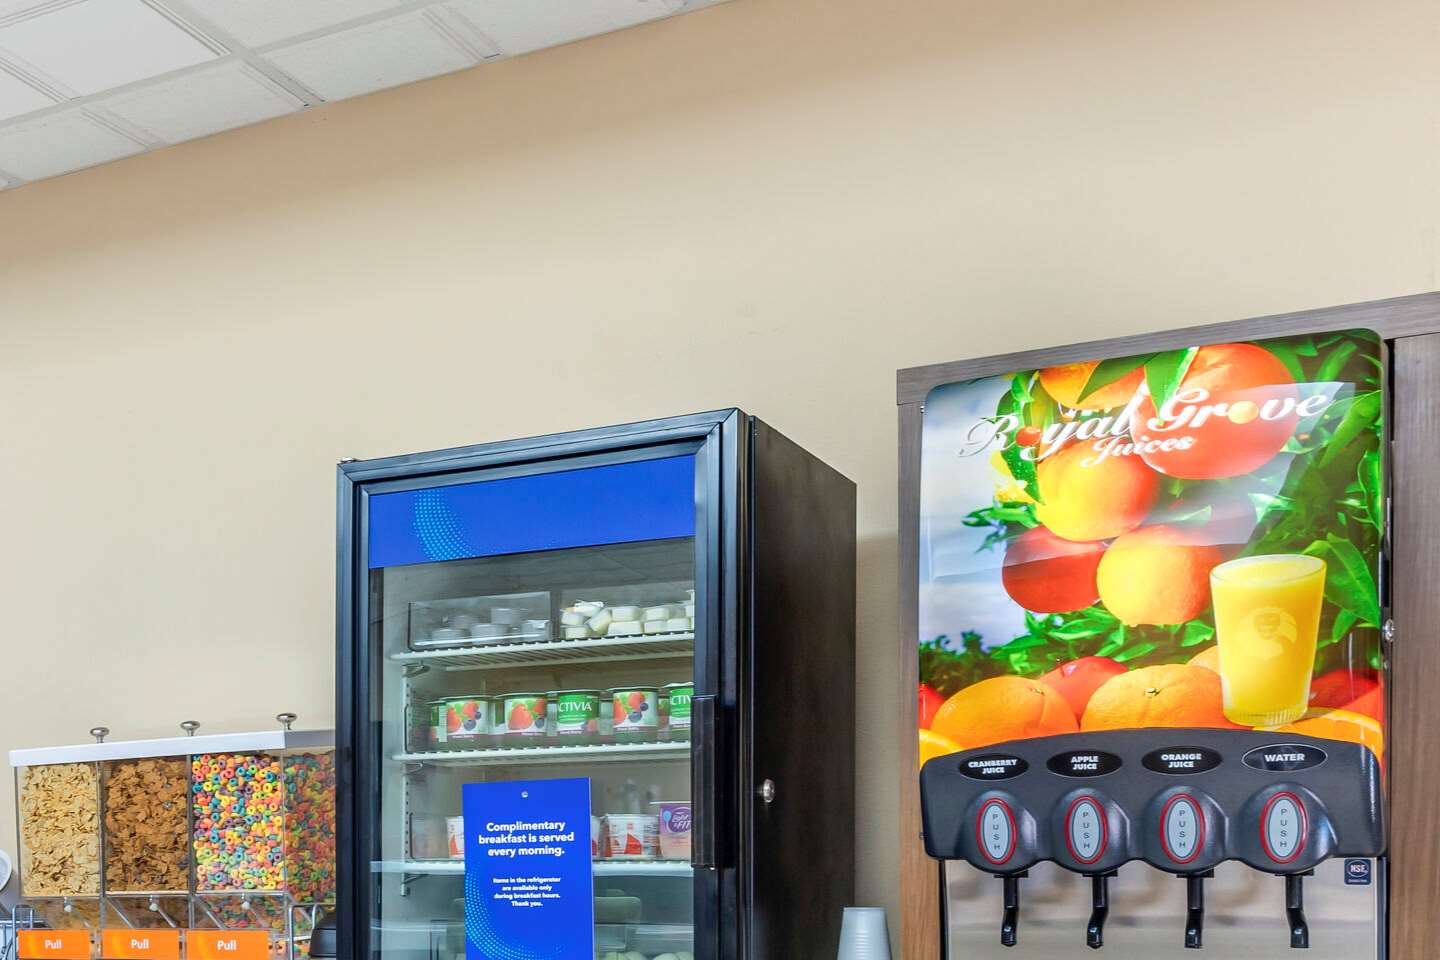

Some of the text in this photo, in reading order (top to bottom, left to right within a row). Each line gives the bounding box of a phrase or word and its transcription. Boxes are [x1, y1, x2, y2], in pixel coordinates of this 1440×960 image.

[1147, 387, 1334, 431] Grove
[1079, 434, 1197, 467] Juices
[558, 701, 593, 712] CTIVIA
[1071, 755, 1099, 763] APPLE
[1161, 753, 1202, 761] ORANGE
[1264, 753, 1306, 762] WATER
[968, 759, 1018, 768] CRANBERRY
[1072, 763, 1098, 771] JUICE
[1168, 761, 1195, 769] JUICE
[982, 767, 1005, 775] JUICE
[486, 821, 566, 833] Complimentary
[992, 813, 1001, 850] PUSH
[1082, 811, 1090, 849] PUSH
[1178, 809, 1186, 848] PUSH
[1280, 808, 1288, 848] PUSH
[478, 831, 575, 844] breakfast is served
[487, 845, 566, 858] every morning.
[539, 884, 553, 892] only
[44, 939, 62, 950] Pull
[131, 939, 149, 950] Pull
[216, 940, 237, 951] Pull
